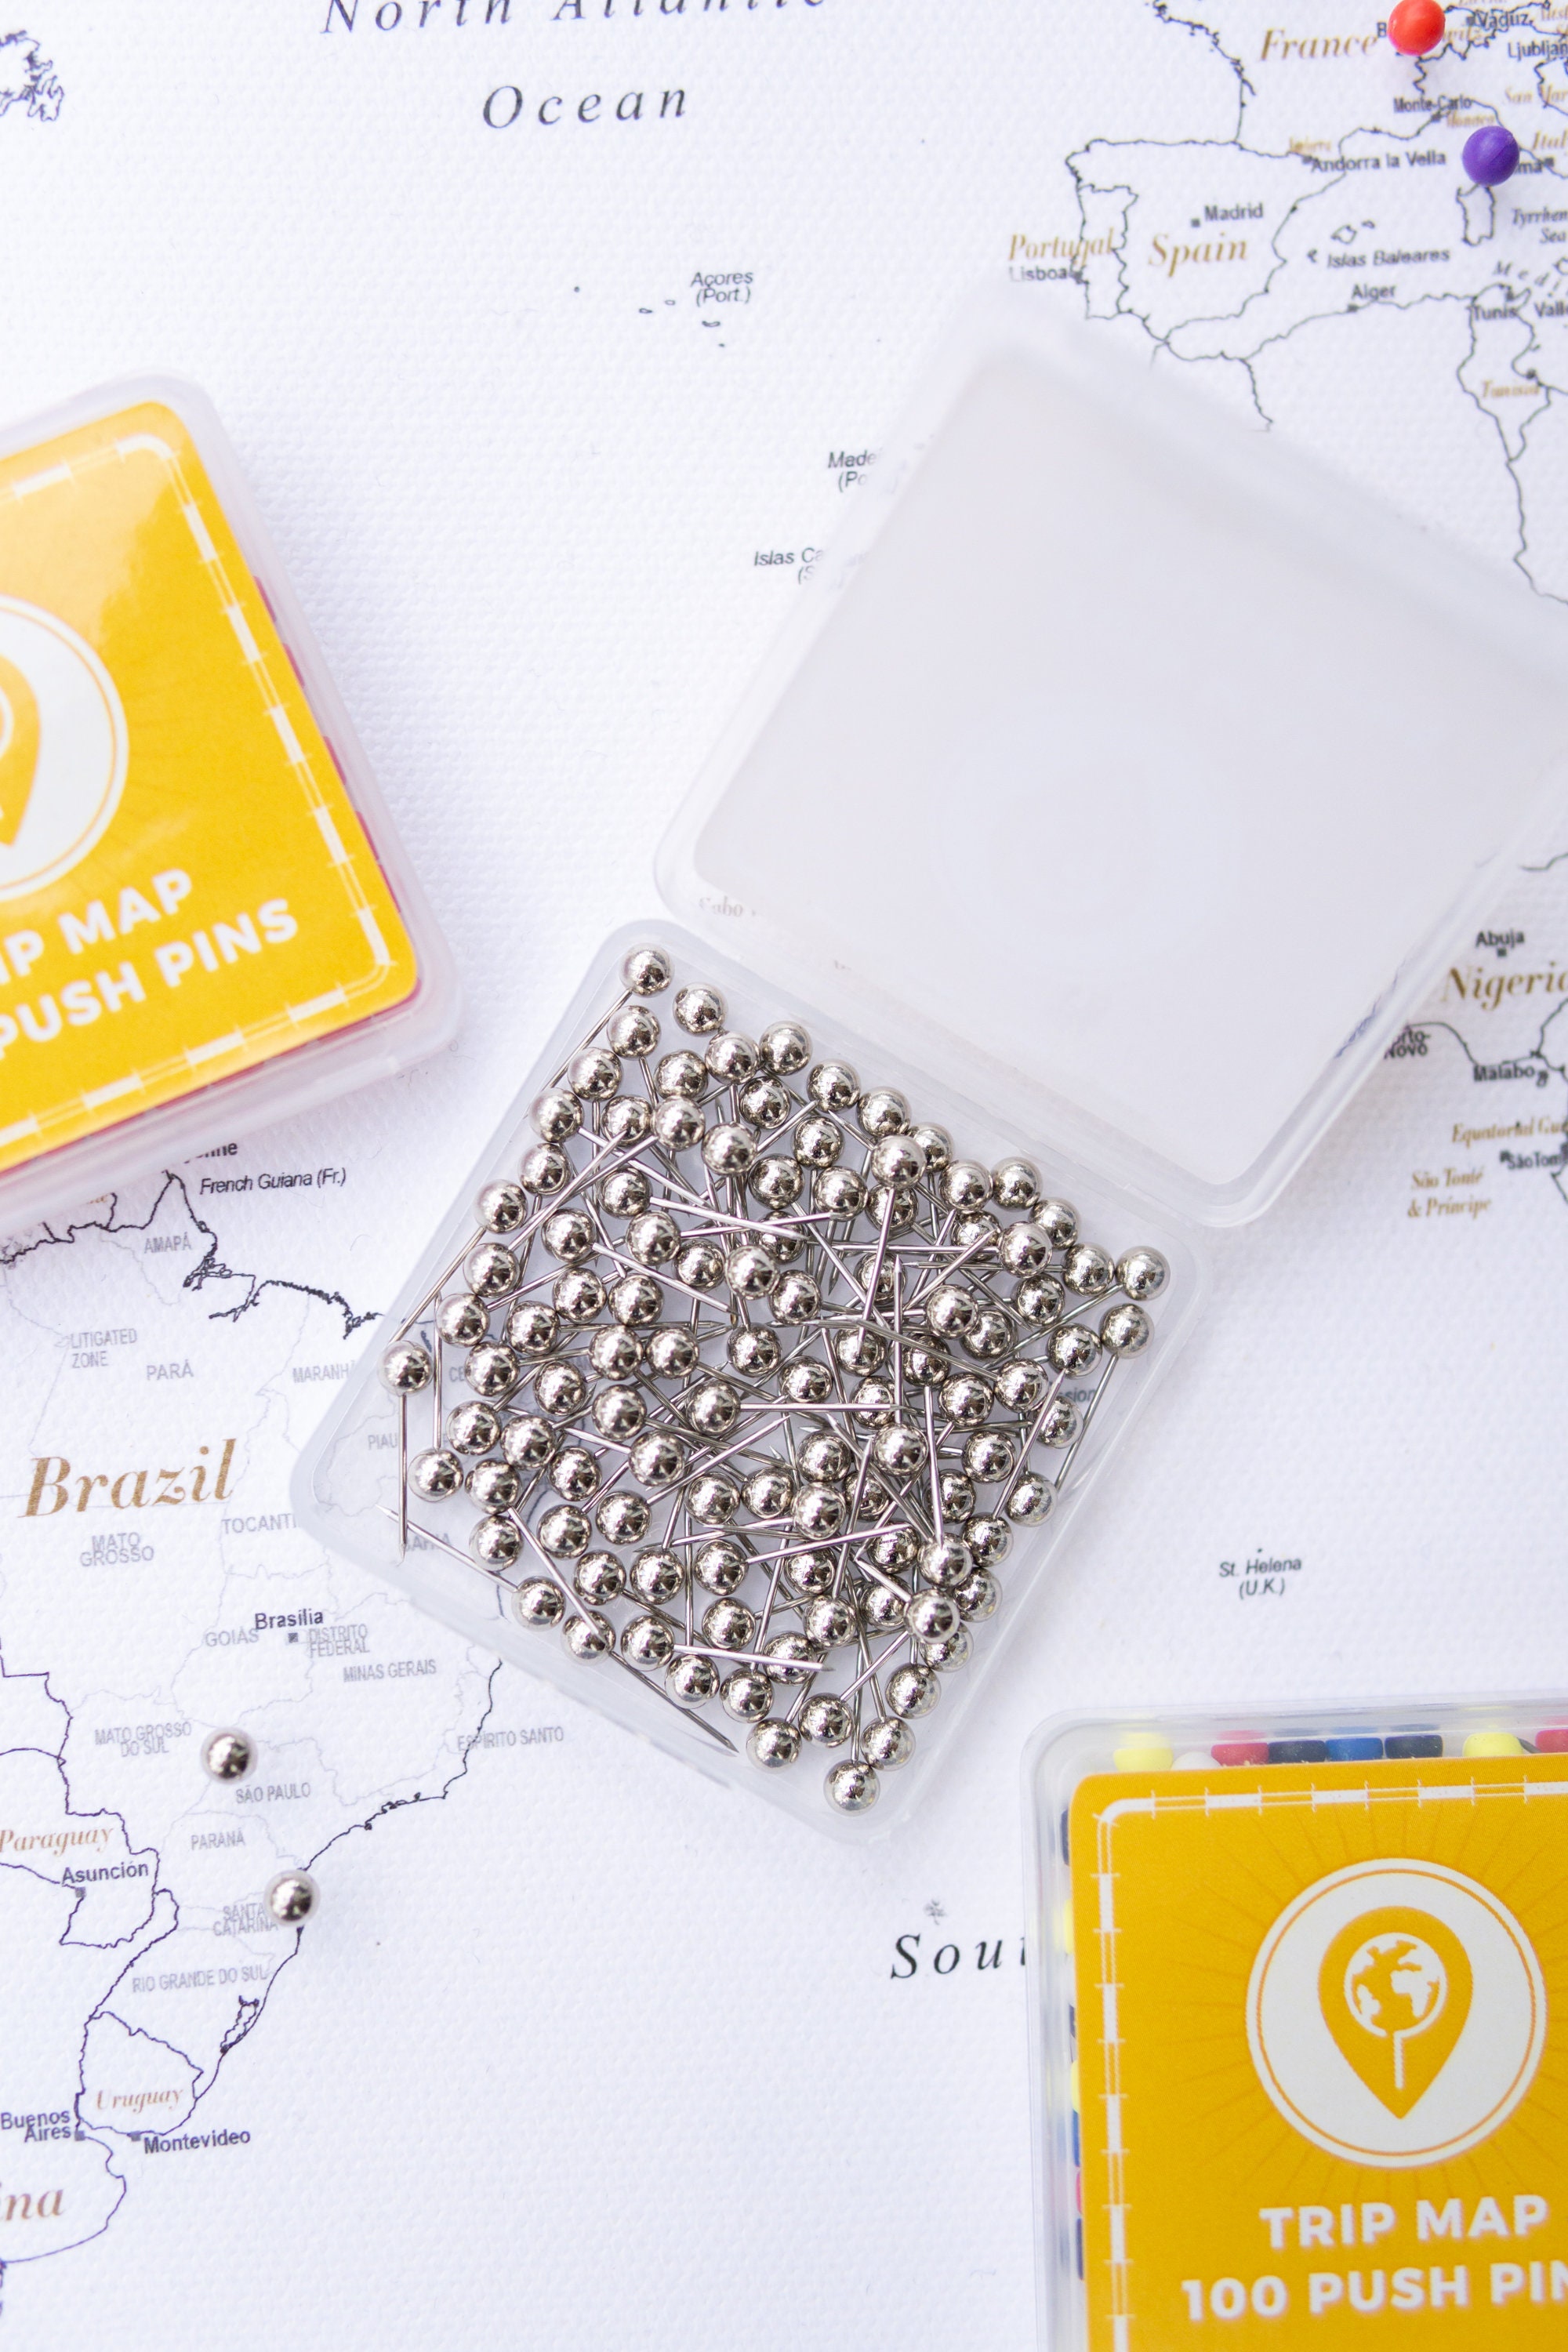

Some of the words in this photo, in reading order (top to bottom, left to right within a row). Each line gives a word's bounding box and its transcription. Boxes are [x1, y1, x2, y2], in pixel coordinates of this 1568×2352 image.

[1260, 28, 1377, 61] France
[483, 84, 687, 129] Ocean
[1394, 95, 1472, 113] Monte-Carlo
[1312, 154, 1381, 174] Andorra
[1386, 153, 1400, 168] la
[1406, 151, 1446, 167] Vella
[1205, 202, 1263, 222] Madrid
[1008, 227, 1115, 269] Portugal
[1149, 233, 1248, 278] Spain
[1327, 252, 1367, 269] Islas
[1373, 248, 1450, 267] Baleares
[691, 270, 753, 289] Açores
[1009, 266, 1068, 282] Lisboa
[695, 286, 751, 307] (Port.)
[1352, 281, 1396, 300] Alger
[828, 447, 880, 469] Made
[754, 550, 795, 566] Islas
[58, 868, 192, 955] MAP
[154, 898, 298, 989] PINS
[1475, 927, 1526, 949] Abuja
[1474, 1061, 1535, 1082] Malabo
[200, 1174, 253, 1195] French
[258, 1171, 312, 1190] Guiana
[317, 1167, 346, 1189] (Fr.)
[144, 1231, 192, 1254] AMAPÁ
[71, 1328, 137, 1349] LITIGATED
[72, 1351, 108, 1369] ZONE
[146, 1359, 194, 1381] PARÁ
[16, 1438, 237, 1519] Brazil
[91, 1531, 140, 1551] MATO
[80, 1545, 154, 1567] GROSSO
[1218, 1561, 1240, 1577] St.
[1245, 1555, 1301, 1575] Helena
[1239, 1577, 1286, 1600] (U.K.)
[255, 1608, 324, 1630] Brasília
[205, 1625, 260, 1648] GOIÁS
[308, 1623, 369, 1645] DISTRITO
[309, 1637, 371, 1659] FEDERAL
[343, 1663, 385, 1683] MINAS
[388, 1658, 437, 1679] GERAIS
[94, 1726, 132, 1745] MATO
[136, 1721, 193, 1743] GROSSO
[457, 1728, 517, 1751] ESPÍRITO
[521, 1726, 564, 1745] SANTO
[120, 1740, 140, 1757] DO
[144, 1735, 169, 1755] SUL
[236, 1784, 264, 1804] SÃO
[267, 1781, 311, 1801] PAULO
[0, 1827, 113, 1857] Paraguay
[191, 1828, 245, 1851] PARANÁ
[62, 1860, 149, 1884] Asunción
[132, 1976, 156, 1993] RIO
[159, 1970, 214, 1991] GRANDE
[217, 1968, 237, 1986] DO
[241, 1965, 267, 1984] SUL
[96, 2088, 183, 2114] Uruguay
[1, 2110, 71, 2131] Buenos
[24, 2125, 72, 2143] Aires
[143, 2128, 251, 2154] Montevideo
[1258, 2201, 1396, 2250] TRIP
[1416, 2194, 1548, 2241] MAP
[1181, 2274, 1288, 2321] 100
[1308, 2265, 1469, 2315] PUSH
